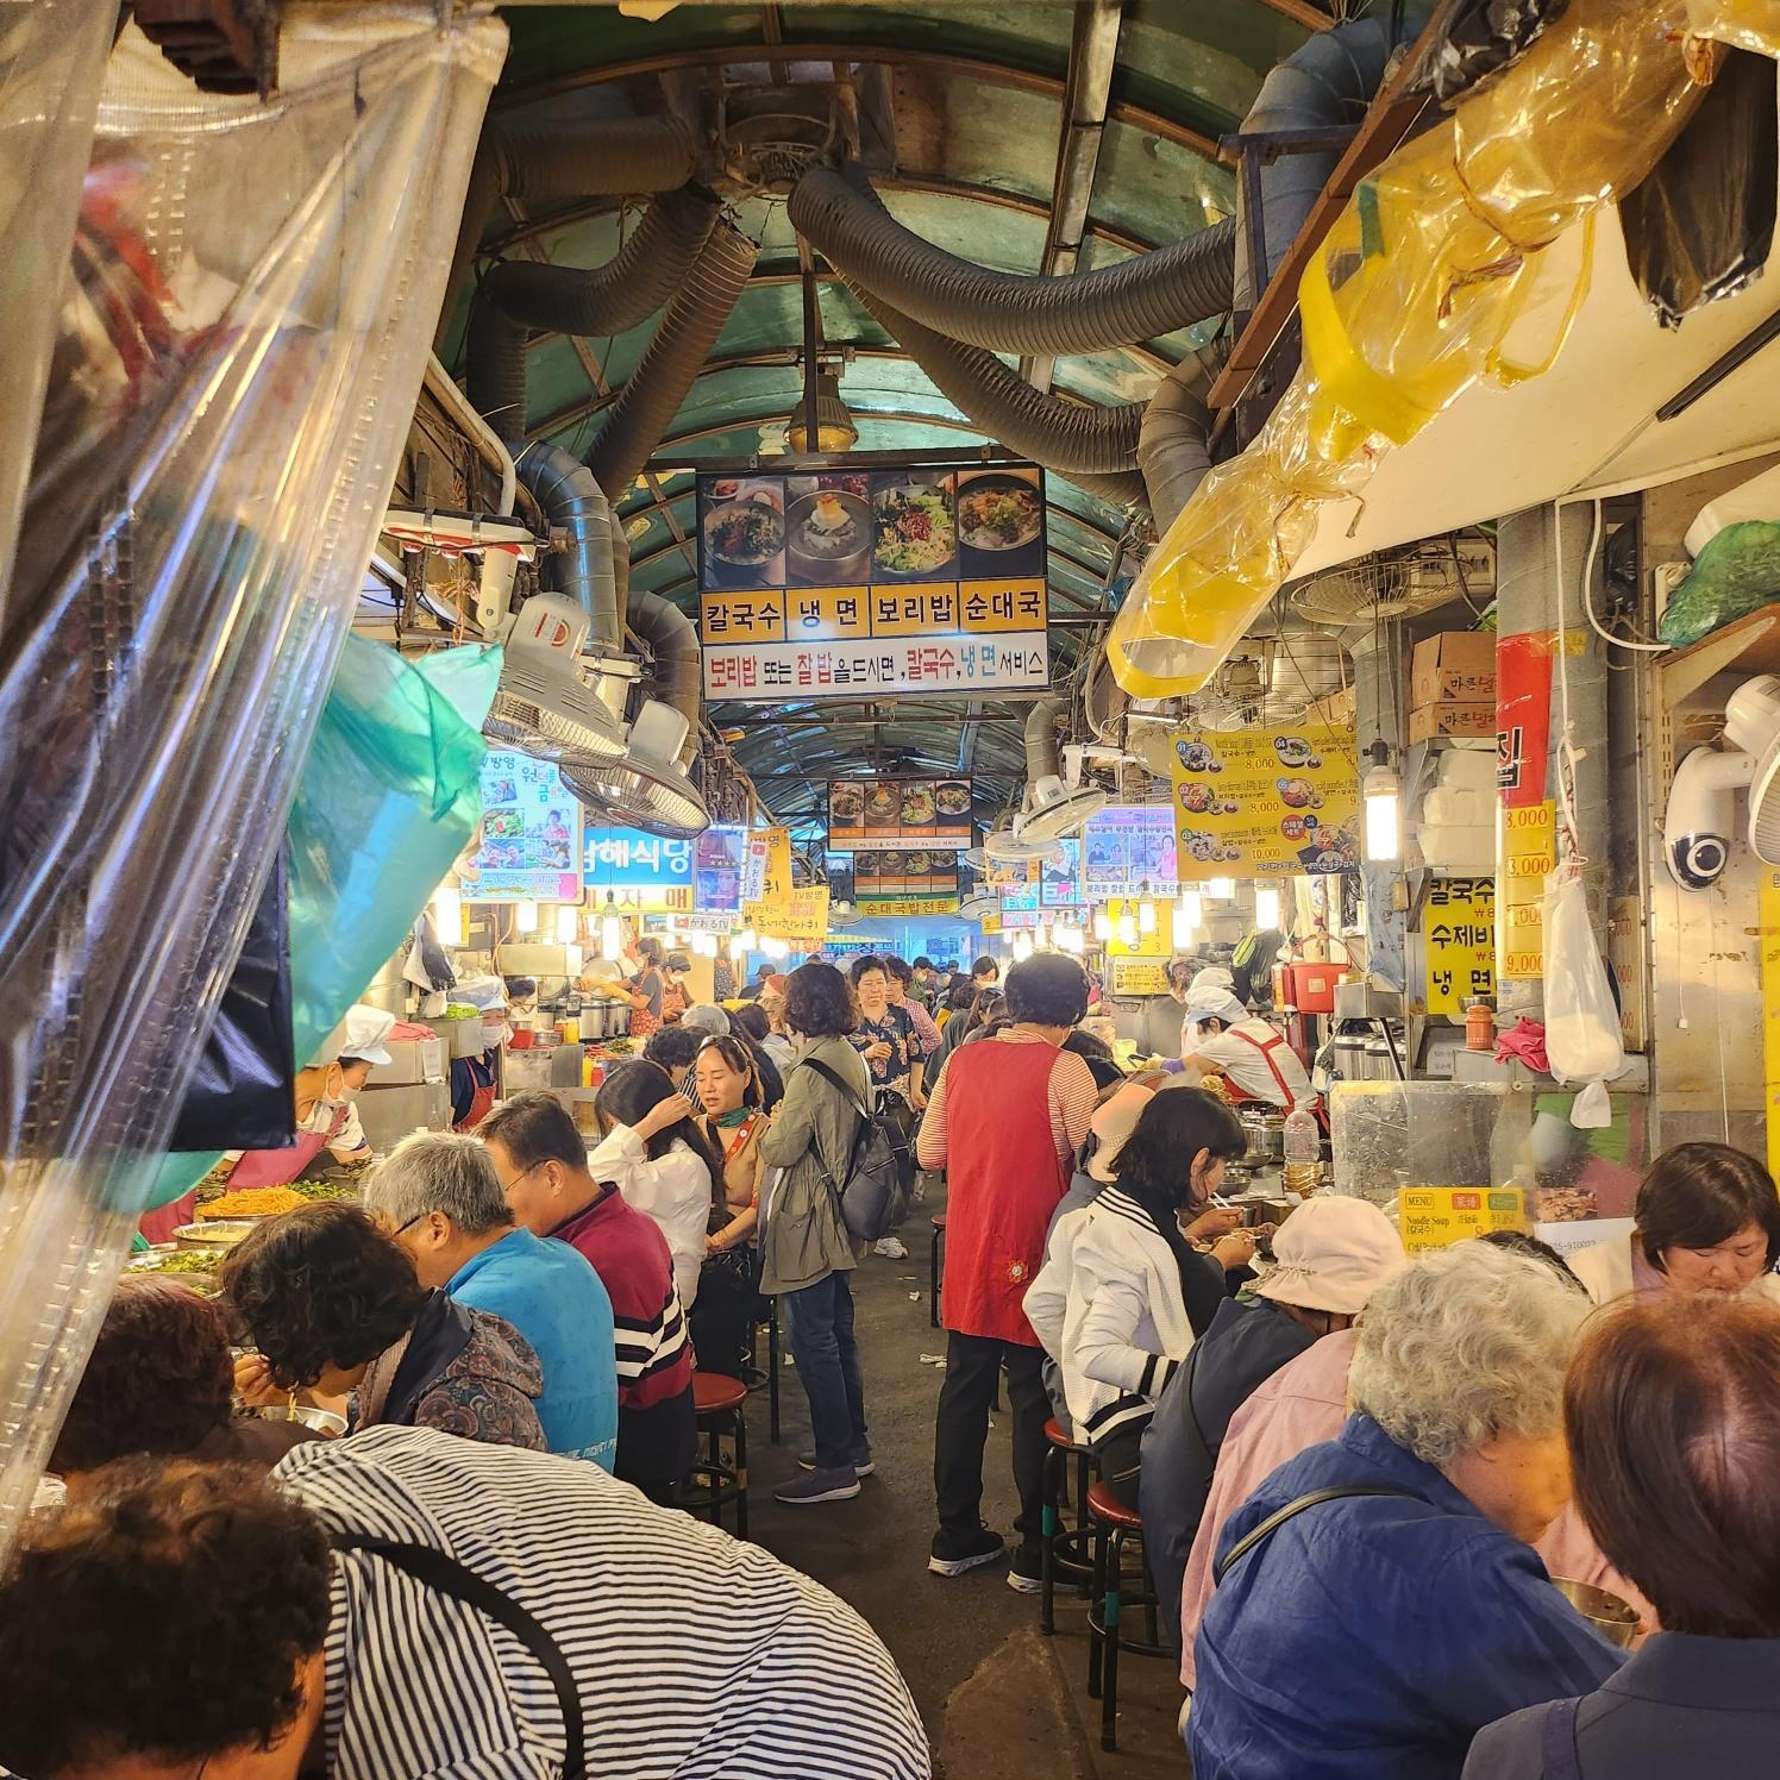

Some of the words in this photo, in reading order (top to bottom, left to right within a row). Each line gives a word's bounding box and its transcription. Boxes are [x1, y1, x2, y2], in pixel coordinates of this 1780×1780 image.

[707, 601, 781, 632] 칼국수
[877, 594, 953, 624] 보리밥
[965, 590, 1041, 620] 순대국
[710, 655, 757, 688] 보리밥
[763, 660, 792, 685] 또는
[1000, 651, 1043, 676] 서비스
[1430, 878, 1495, 906] 칼국수
[865, 900, 950, 915] 순대국밥전문
[1431, 924, 1495, 950] 수제비
[1407, 1195, 1432, 1206] MENU
